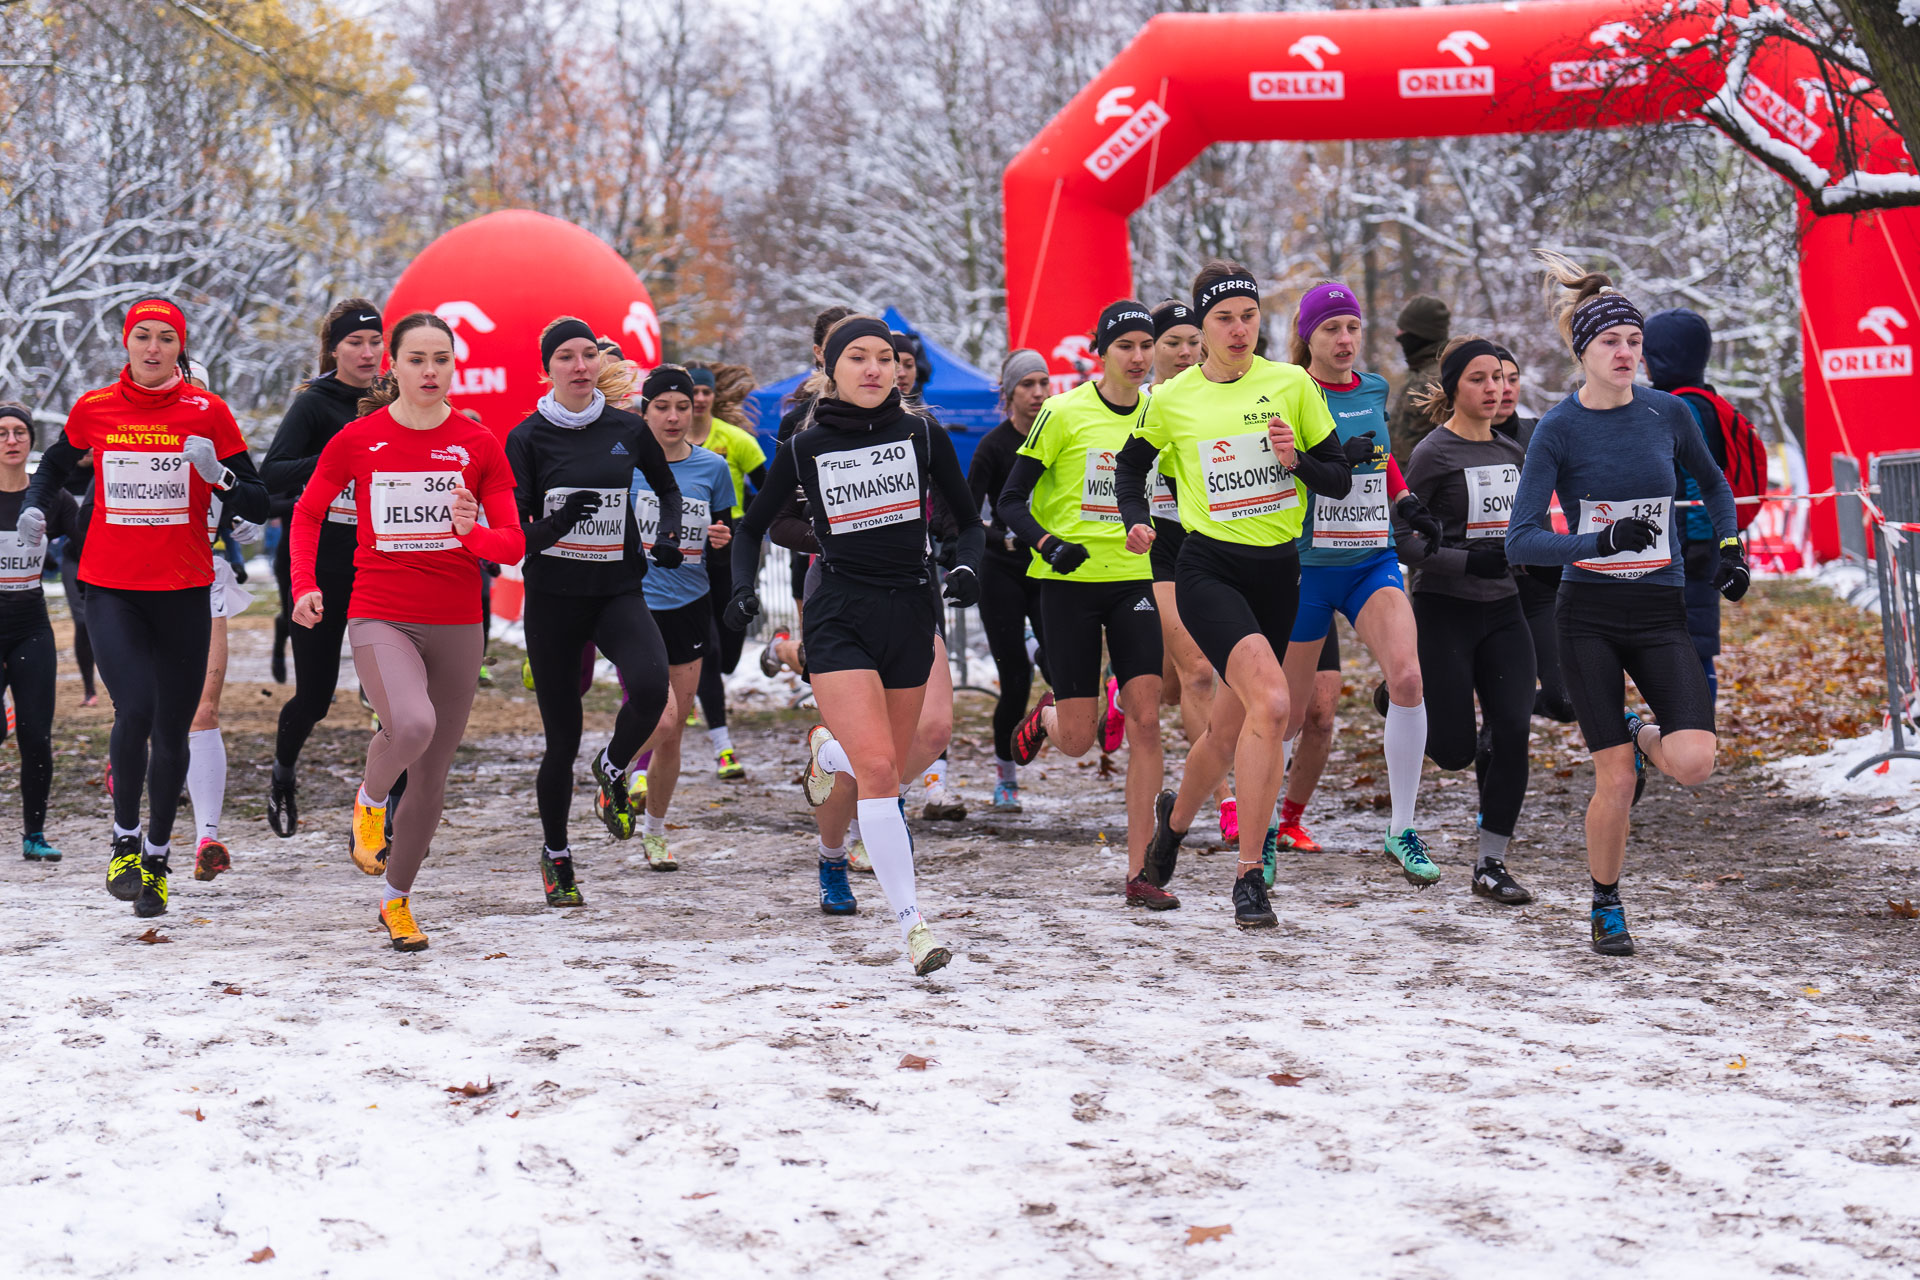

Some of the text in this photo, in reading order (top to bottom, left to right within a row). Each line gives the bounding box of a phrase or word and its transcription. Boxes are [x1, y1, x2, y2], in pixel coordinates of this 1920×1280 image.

[1257, 77, 1336, 94] ORLEN
[1406, 74, 1486, 91] ORLEN
[1746, 85, 1814, 141] ORLEN
[1096, 110, 1158, 171] ORLEN
[1210, 280, 1257, 296] TERREX
[1118, 311, 1154, 324] TERREX
[1829, 352, 1905, 372] ORLEN
[449, 368, 506, 394] LEN
[1244, 413, 1258, 421] KS
[129, 424, 168, 432] PODLASIE
[106, 433, 180, 446] BIAŁYSTOK
[870, 446, 906, 466] 240
[1212, 455, 1236, 463] ORLEN
[150, 457, 182, 471] 369
[830, 459, 861, 471] FUEL
[424, 477, 457, 492] 366
[1208, 464, 1291, 493] ŚCISŁOWSKA
[1363, 478, 1382, 493] 571
[825, 472, 916, 506] SZYMAŃSKA
[384, 505, 453, 523] JELSKA
[682, 502, 705, 517] 243
[1232, 503, 1280, 518] BYTOM 2024
[1318, 505, 1387, 522] ŁUKASIEWICZ
[1632, 503, 1662, 518] 134
[573, 519, 622, 535] TKOWIAK
[852, 513, 903, 530] BYTOM 2024
[1592, 517, 1615, 525] ORLEN
[561, 551, 588, 559] BYTOM
